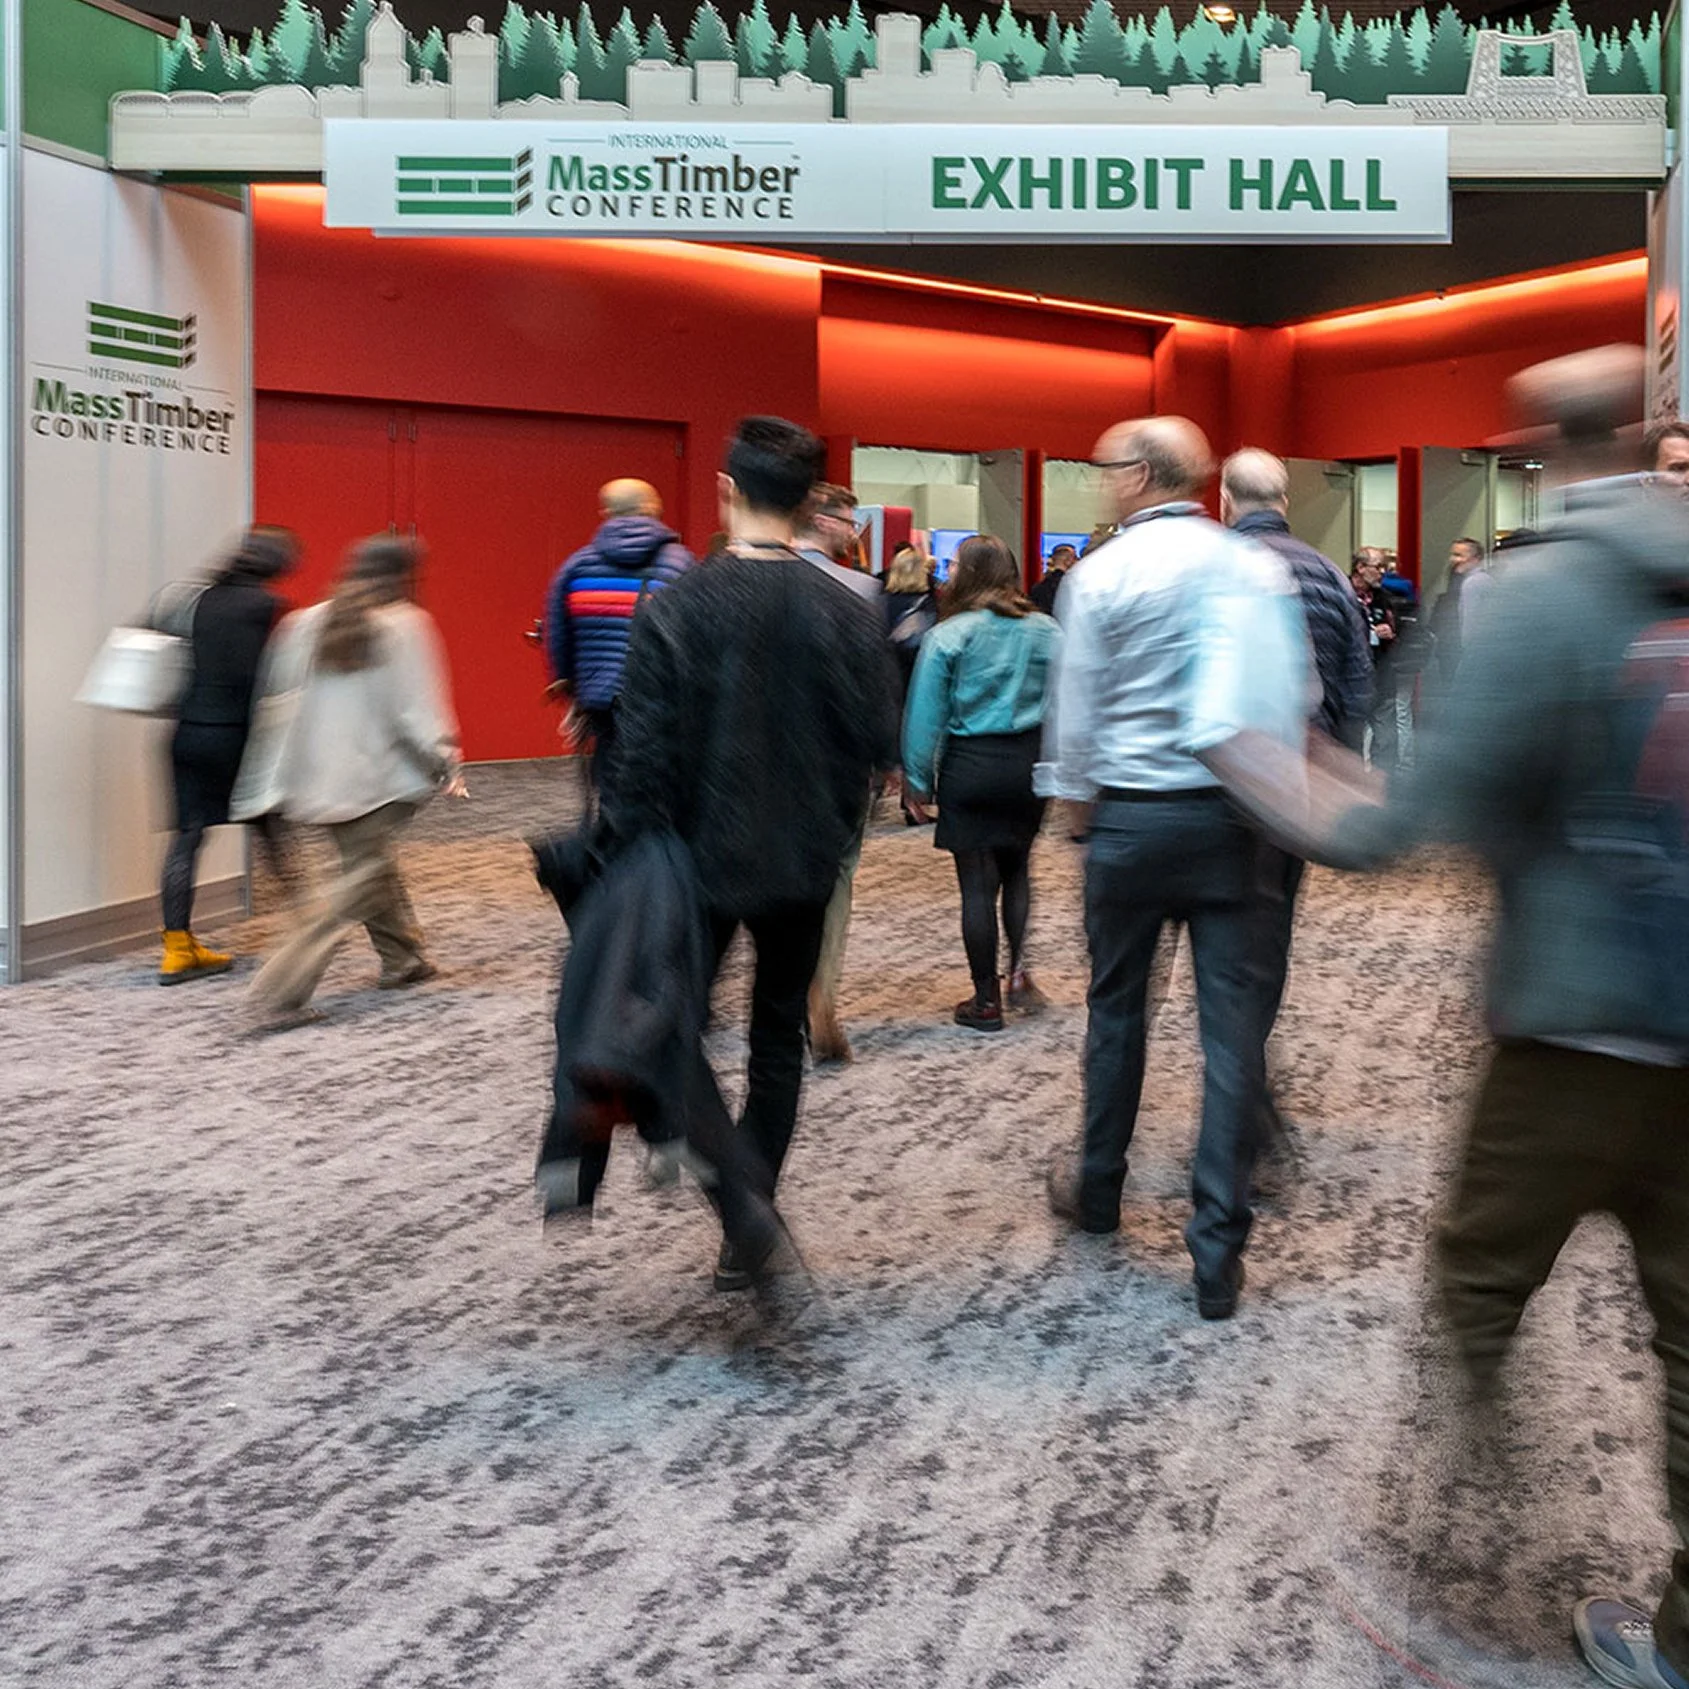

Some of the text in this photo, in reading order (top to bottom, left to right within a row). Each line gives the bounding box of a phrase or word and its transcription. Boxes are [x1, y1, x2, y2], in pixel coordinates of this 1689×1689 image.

[608, 134, 729, 149] INTERNATIONAL
[931, 156, 1397, 211] EXHIBIT HALL
[547, 195, 794, 219] CONFERENCE
[87, 365, 183, 391] INTERNATIONAL
[31, 414, 231, 456] CONFERENCE
